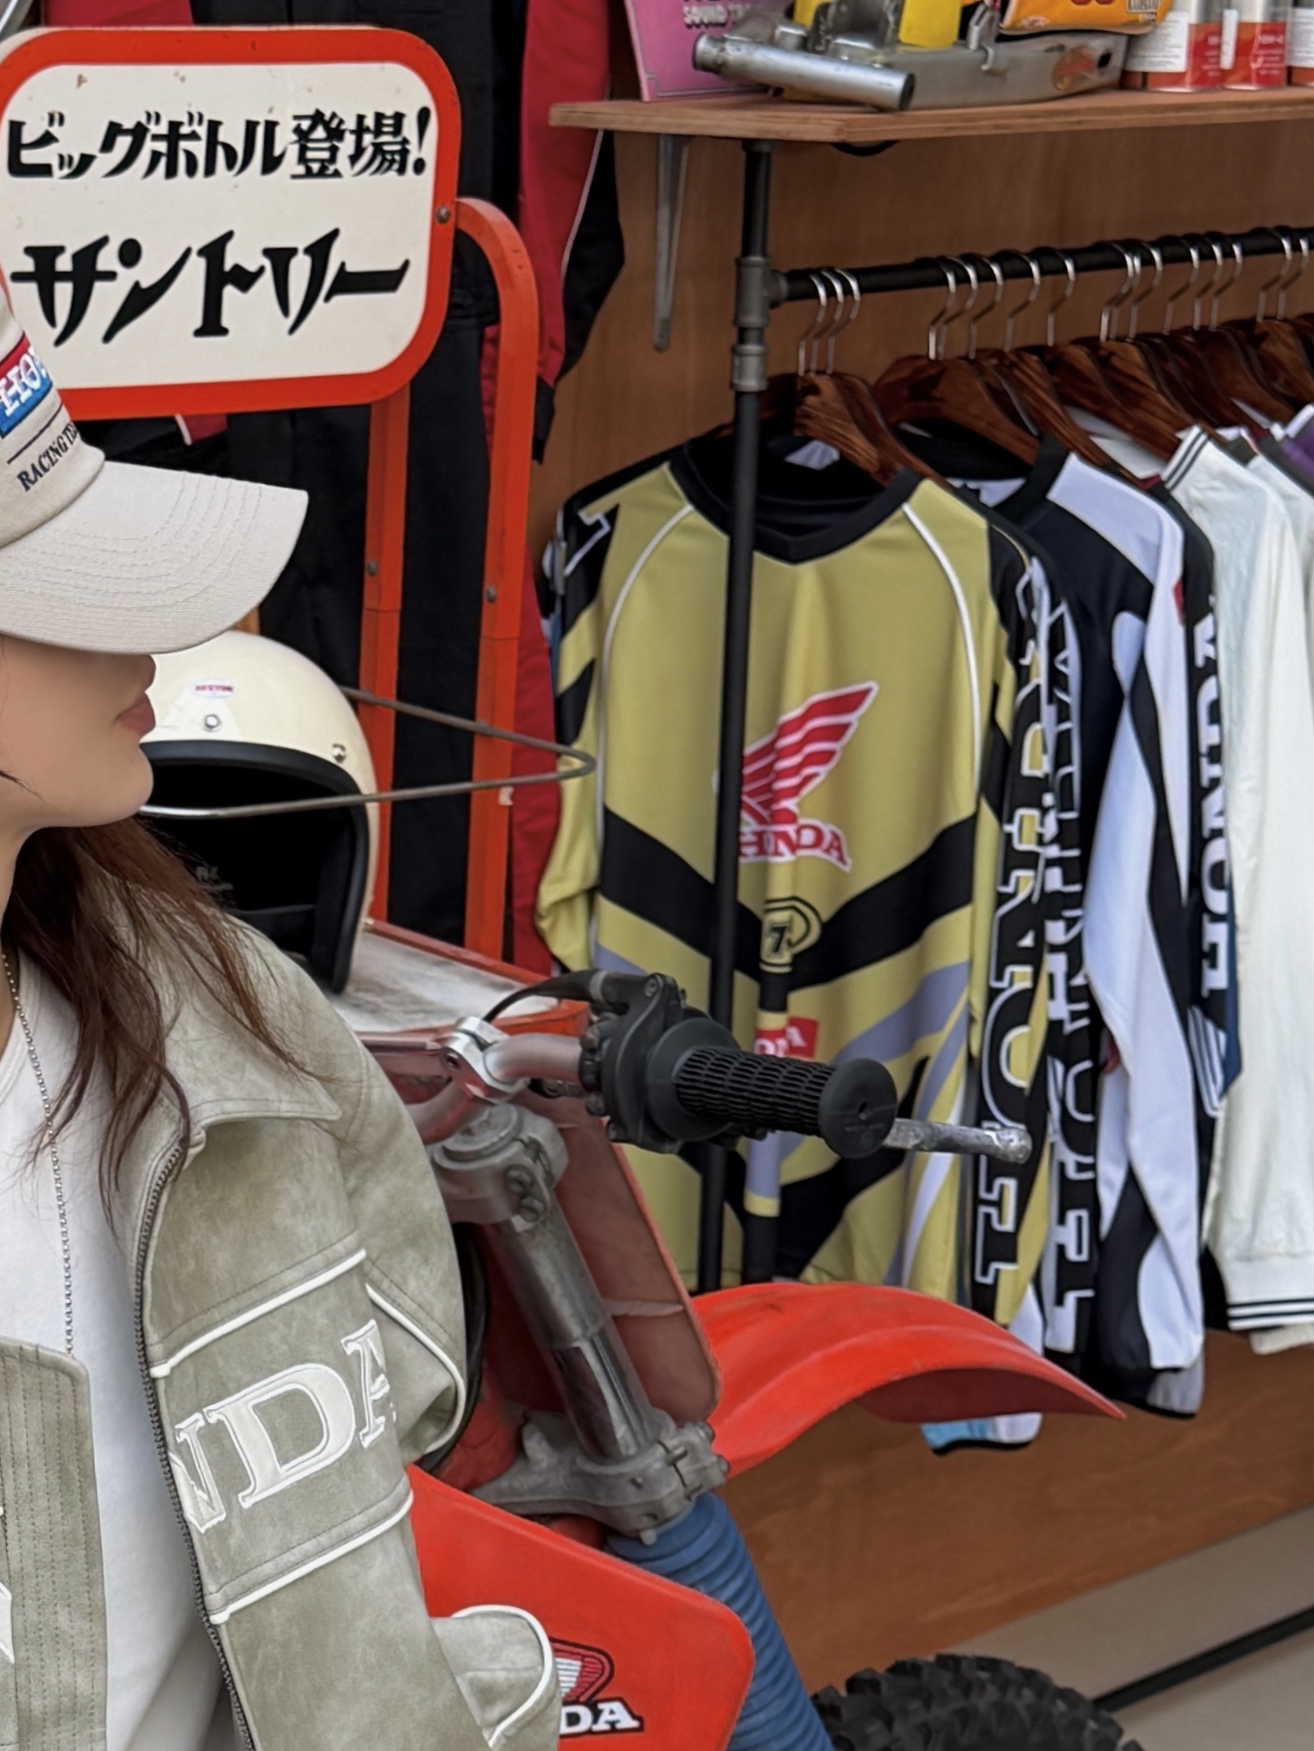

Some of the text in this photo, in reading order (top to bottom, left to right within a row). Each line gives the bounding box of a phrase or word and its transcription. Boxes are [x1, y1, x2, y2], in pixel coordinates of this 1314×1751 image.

[6, 106, 432, 180] ビッグボトル登場!
[10, 228, 410, 347] サントリー
[17, 434, 69, 492] RACING
